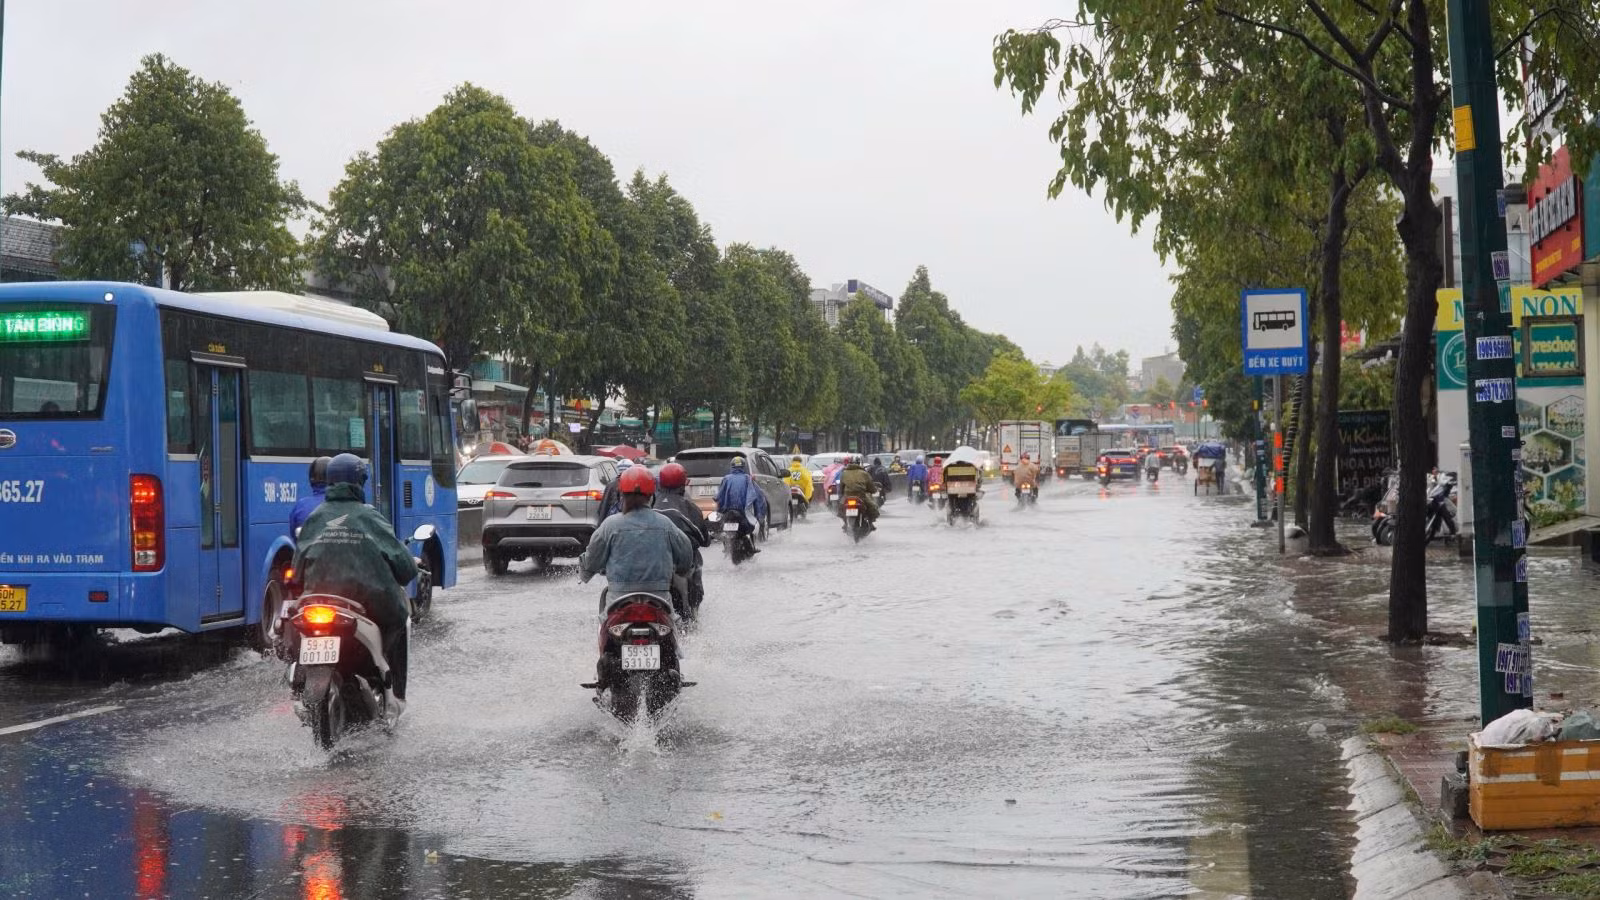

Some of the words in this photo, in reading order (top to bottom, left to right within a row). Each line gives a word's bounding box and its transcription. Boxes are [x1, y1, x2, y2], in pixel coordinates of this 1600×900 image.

[1522, 294, 1577, 316] NON
[1268, 356, 1280, 368] XE
[0, 480, 44, 503] 65.27
[18, 555, 33, 563] KHI
[37, 555, 50, 563] RA
[53, 553, 72, 563] VÀO
[76, 555, 104, 565] TRẠM
